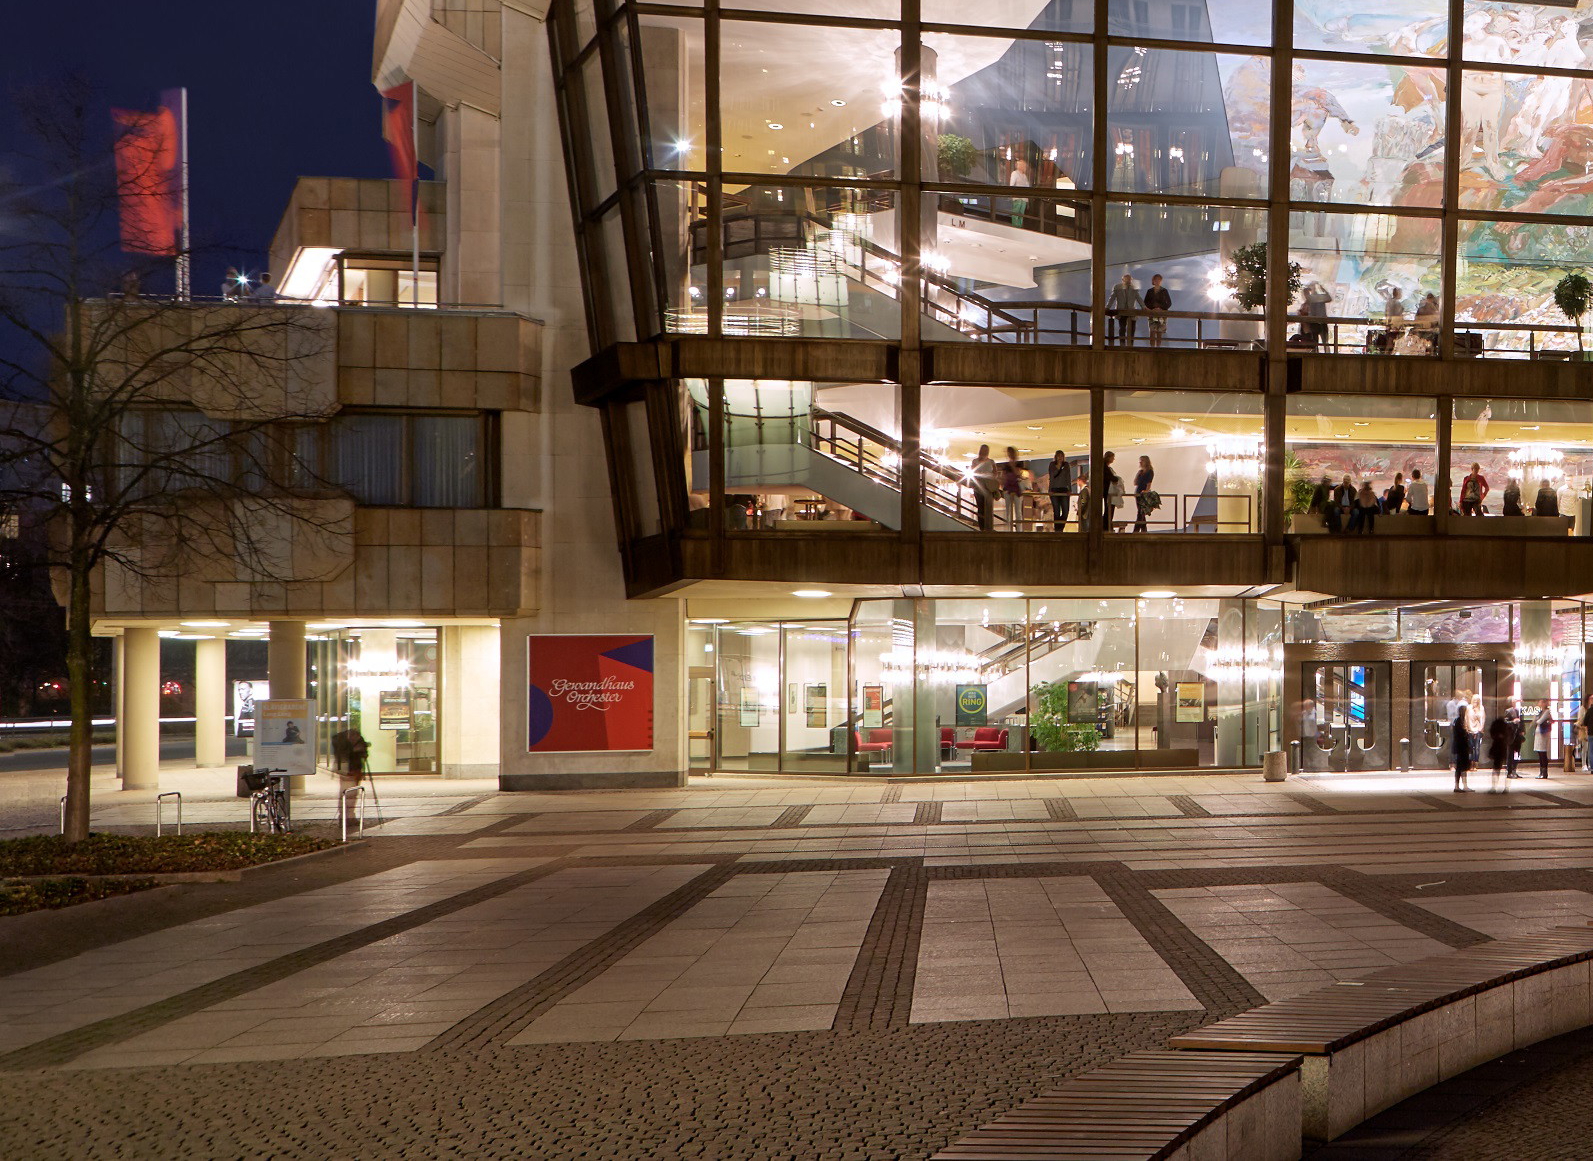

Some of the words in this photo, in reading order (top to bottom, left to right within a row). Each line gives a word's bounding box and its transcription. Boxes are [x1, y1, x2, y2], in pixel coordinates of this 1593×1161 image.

[548, 675, 635, 697] Gewandhaus
[566, 690, 624, 711] Orchester
[962, 698, 982, 706] RING
